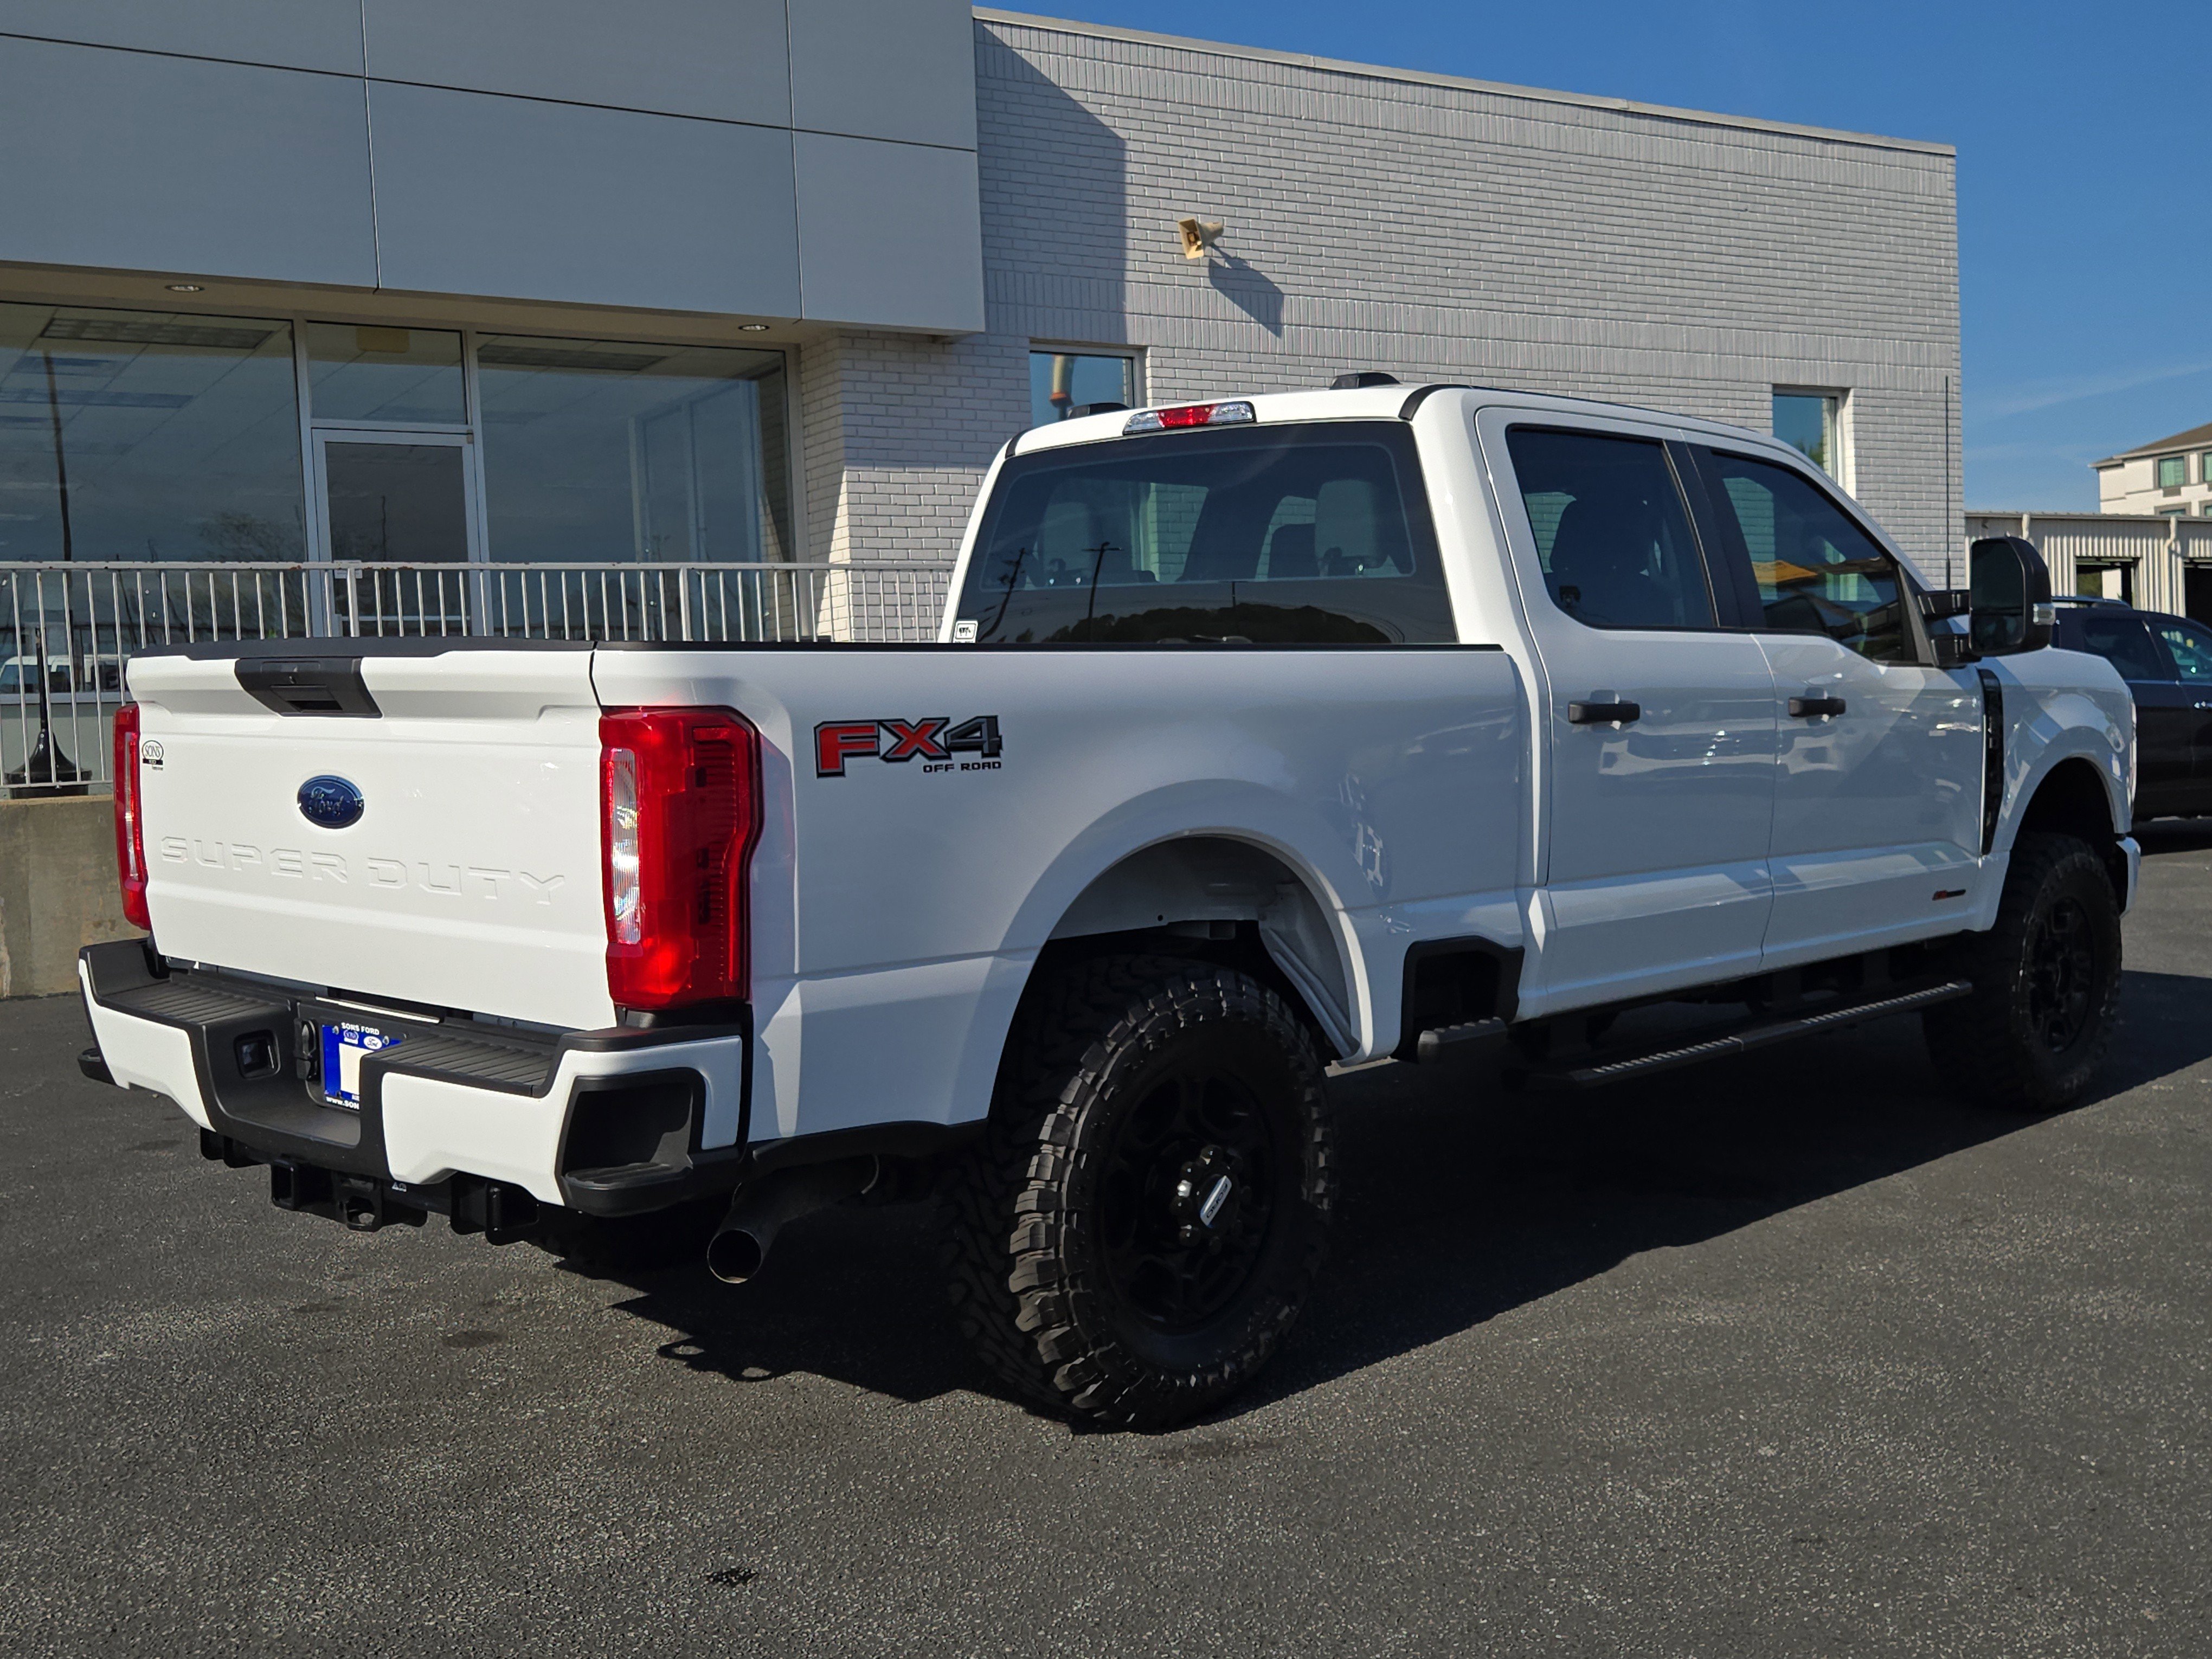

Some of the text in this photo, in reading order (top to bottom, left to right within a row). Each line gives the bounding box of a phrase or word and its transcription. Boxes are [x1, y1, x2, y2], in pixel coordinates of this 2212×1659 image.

[814, 715, 1003, 779] FX4
[923, 761, 1002, 773] OFF ROAD
[308, 786, 344, 816] Ford
[161, 835, 565, 905] SUPER DUTY
[341, 1022, 360, 1032] SONS
[361, 1026, 380, 1036] FORD
[325, 1096, 359, 1110] www.SON
